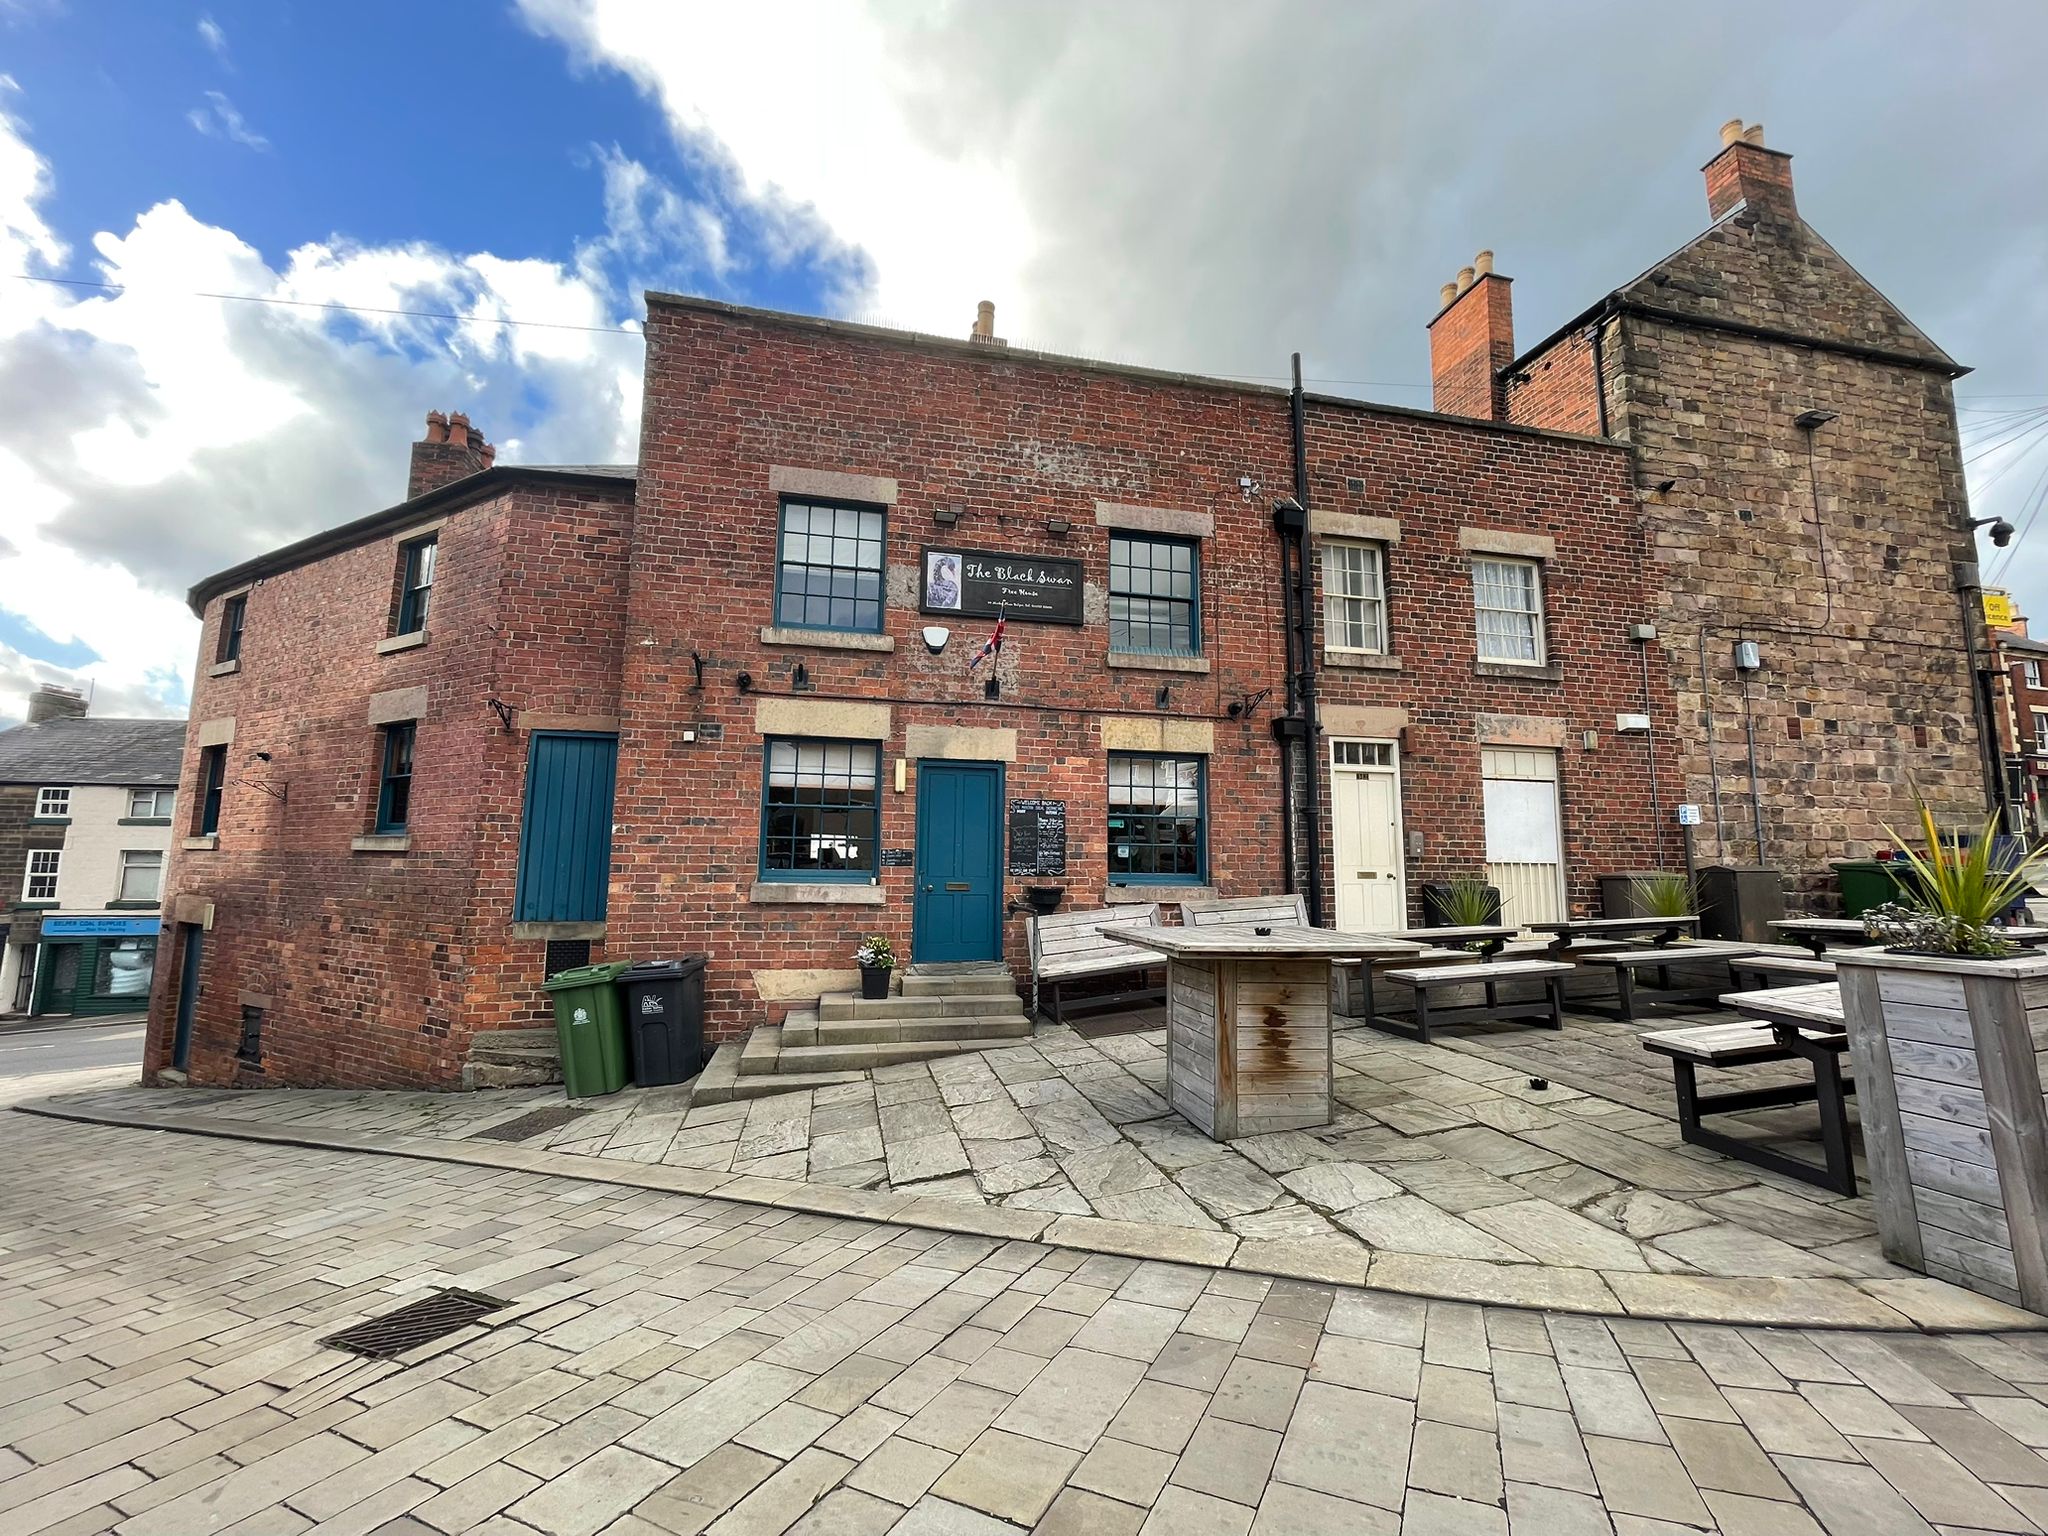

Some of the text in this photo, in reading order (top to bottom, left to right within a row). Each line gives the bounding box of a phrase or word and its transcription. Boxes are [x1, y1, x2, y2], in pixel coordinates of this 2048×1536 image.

[966, 563, 1073, 585] The Black Swan
[1001, 587, 1039, 597] Free House
[1989, 603, 2001, 611] Off
